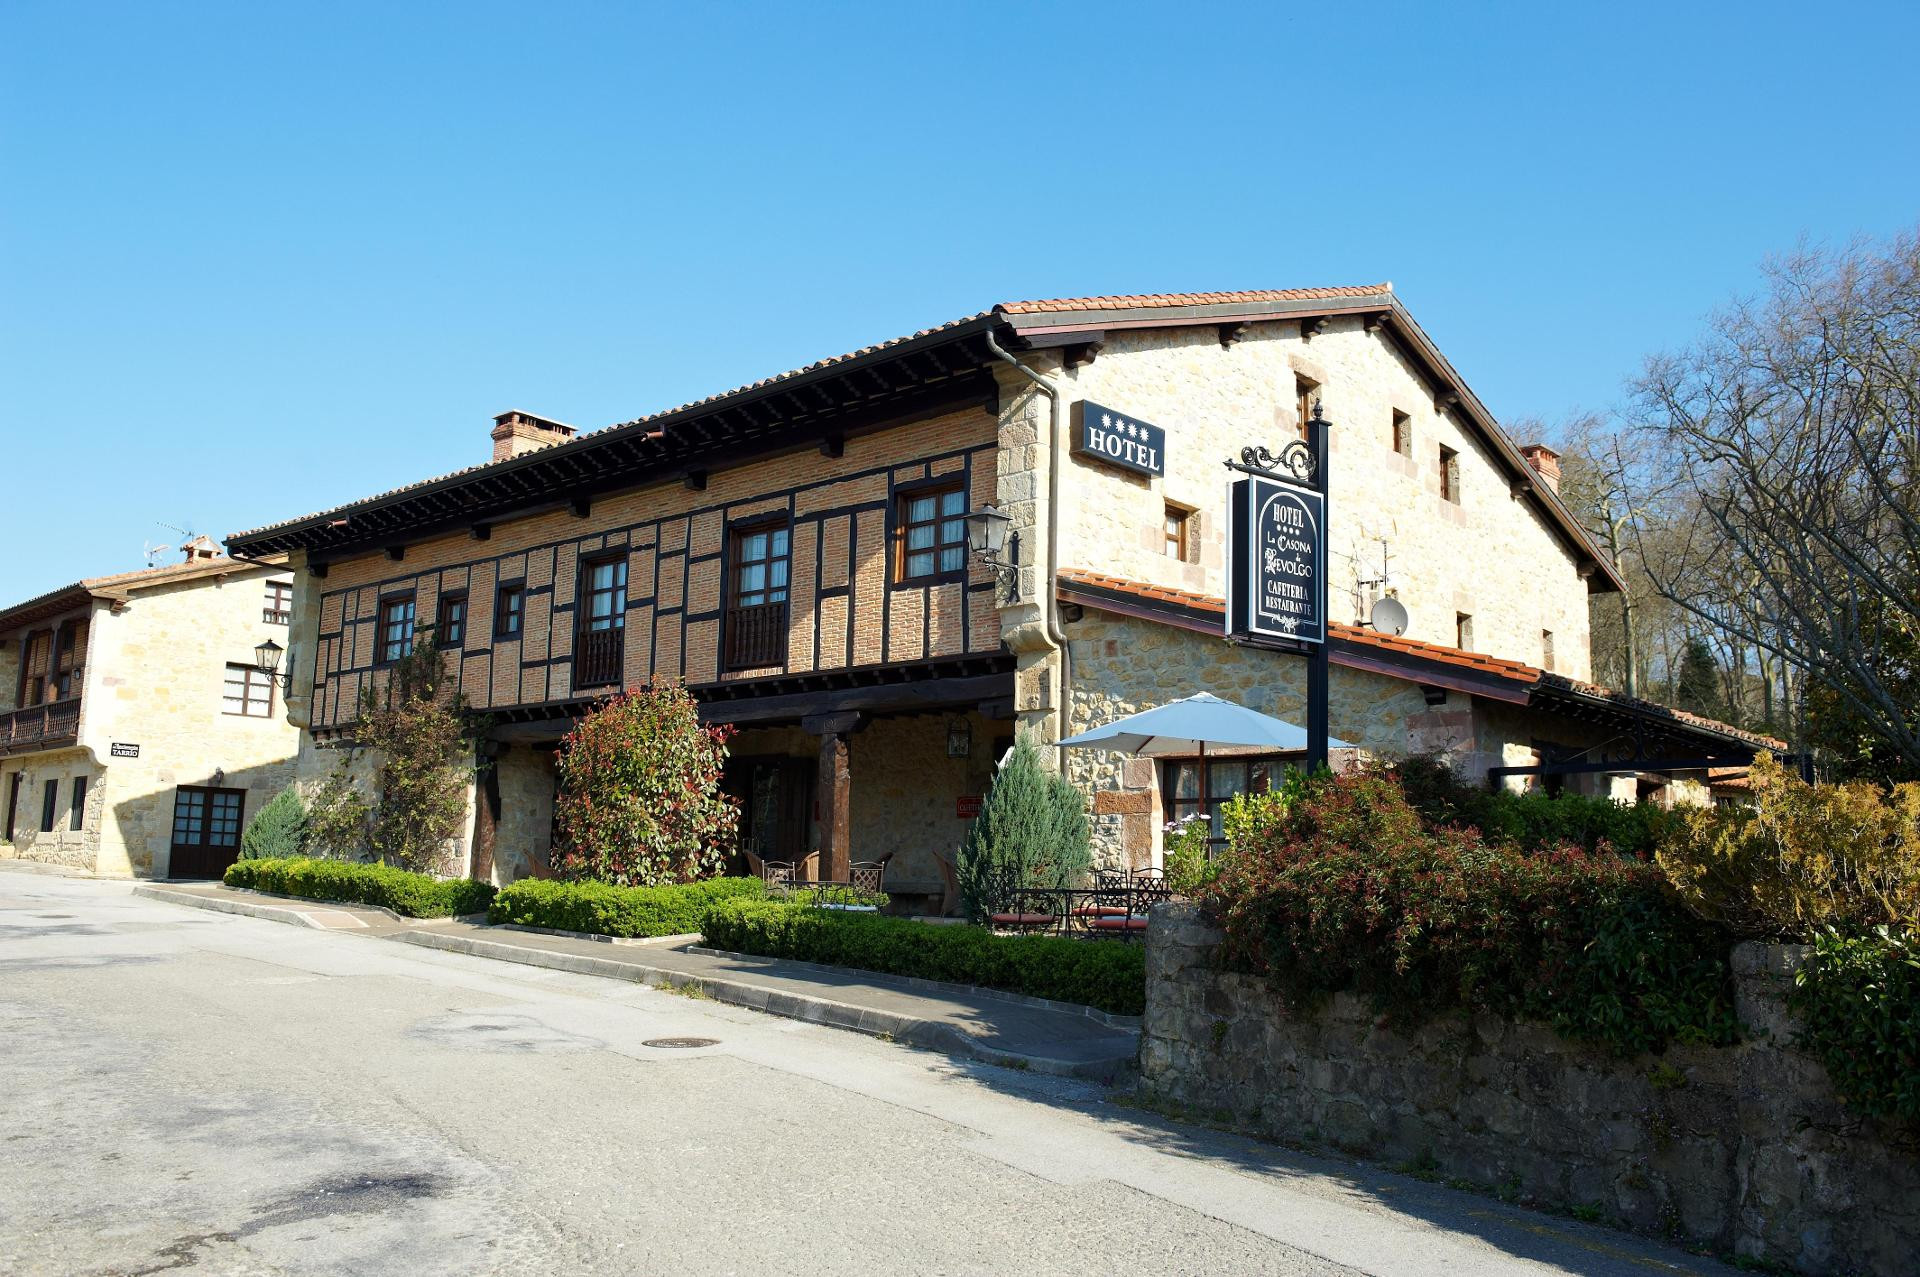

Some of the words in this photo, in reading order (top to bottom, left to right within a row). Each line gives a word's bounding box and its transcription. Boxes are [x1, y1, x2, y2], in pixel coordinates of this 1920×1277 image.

[1089, 426, 1160, 471] HOTEL
[1273, 503, 1304, 528] HOTEL
[1277, 534, 1311, 554] CASONA
[1265, 547, 1313, 578] REVOLGO
[1265, 595, 1312, 616] RESTAURANTE
